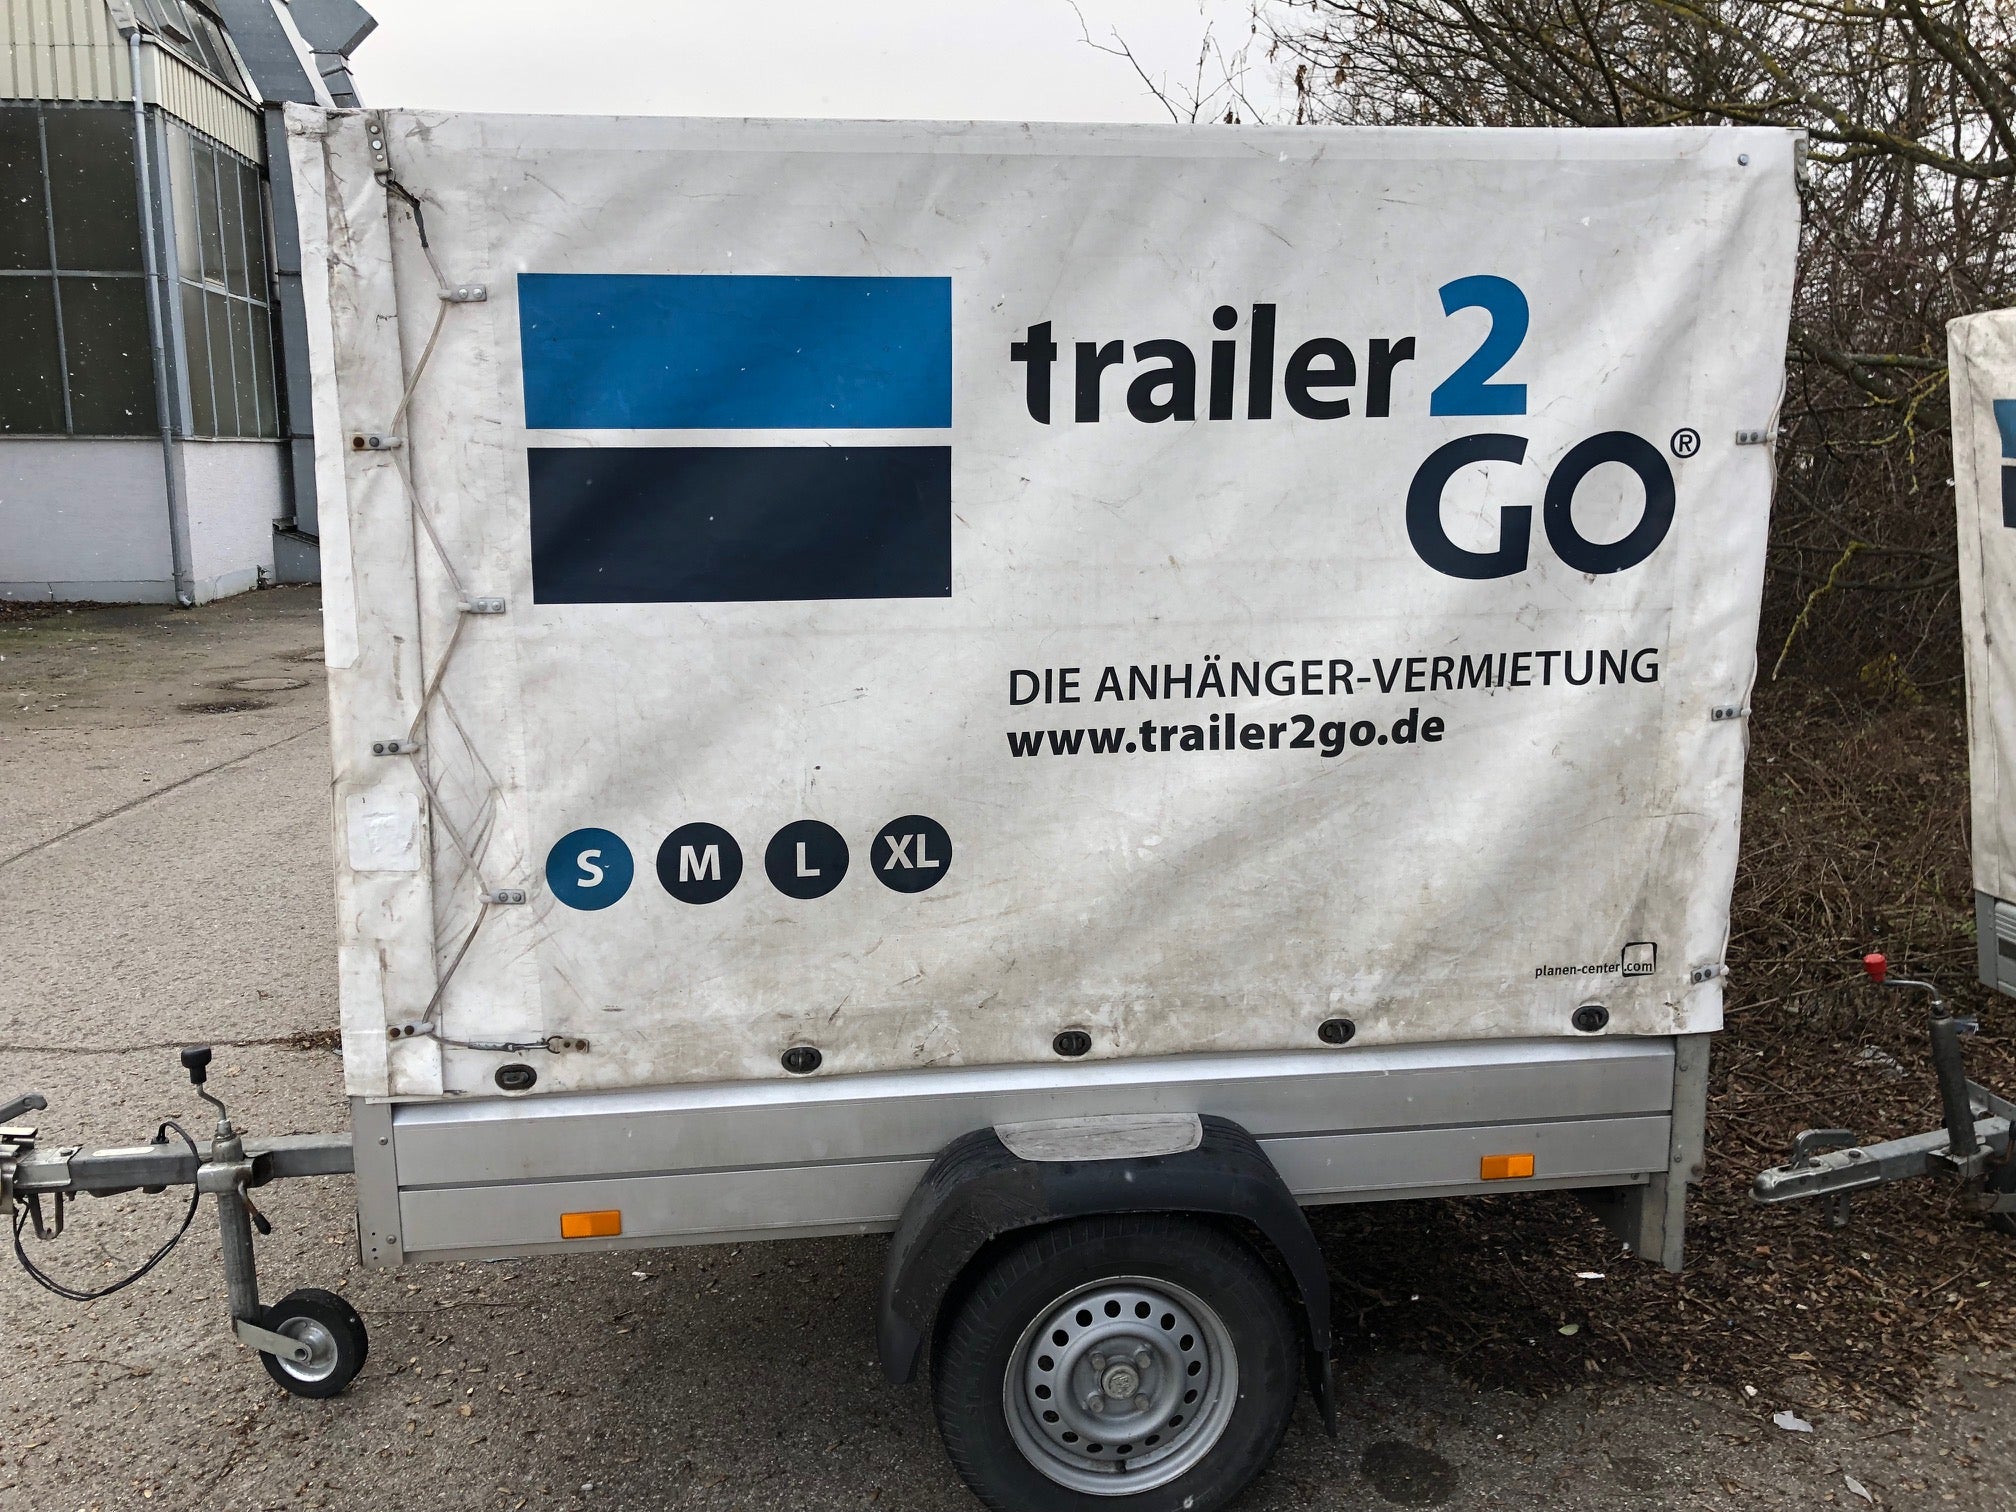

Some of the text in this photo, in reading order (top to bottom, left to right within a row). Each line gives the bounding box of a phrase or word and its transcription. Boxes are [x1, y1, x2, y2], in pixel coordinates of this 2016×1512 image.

[1009, 647, 1660, 706] DIE ANHÄNGER-VERMIETUNG
[1006, 707, 1446, 758] www.trailer2go.de
[576, 833, 940, 888] S M L XL
